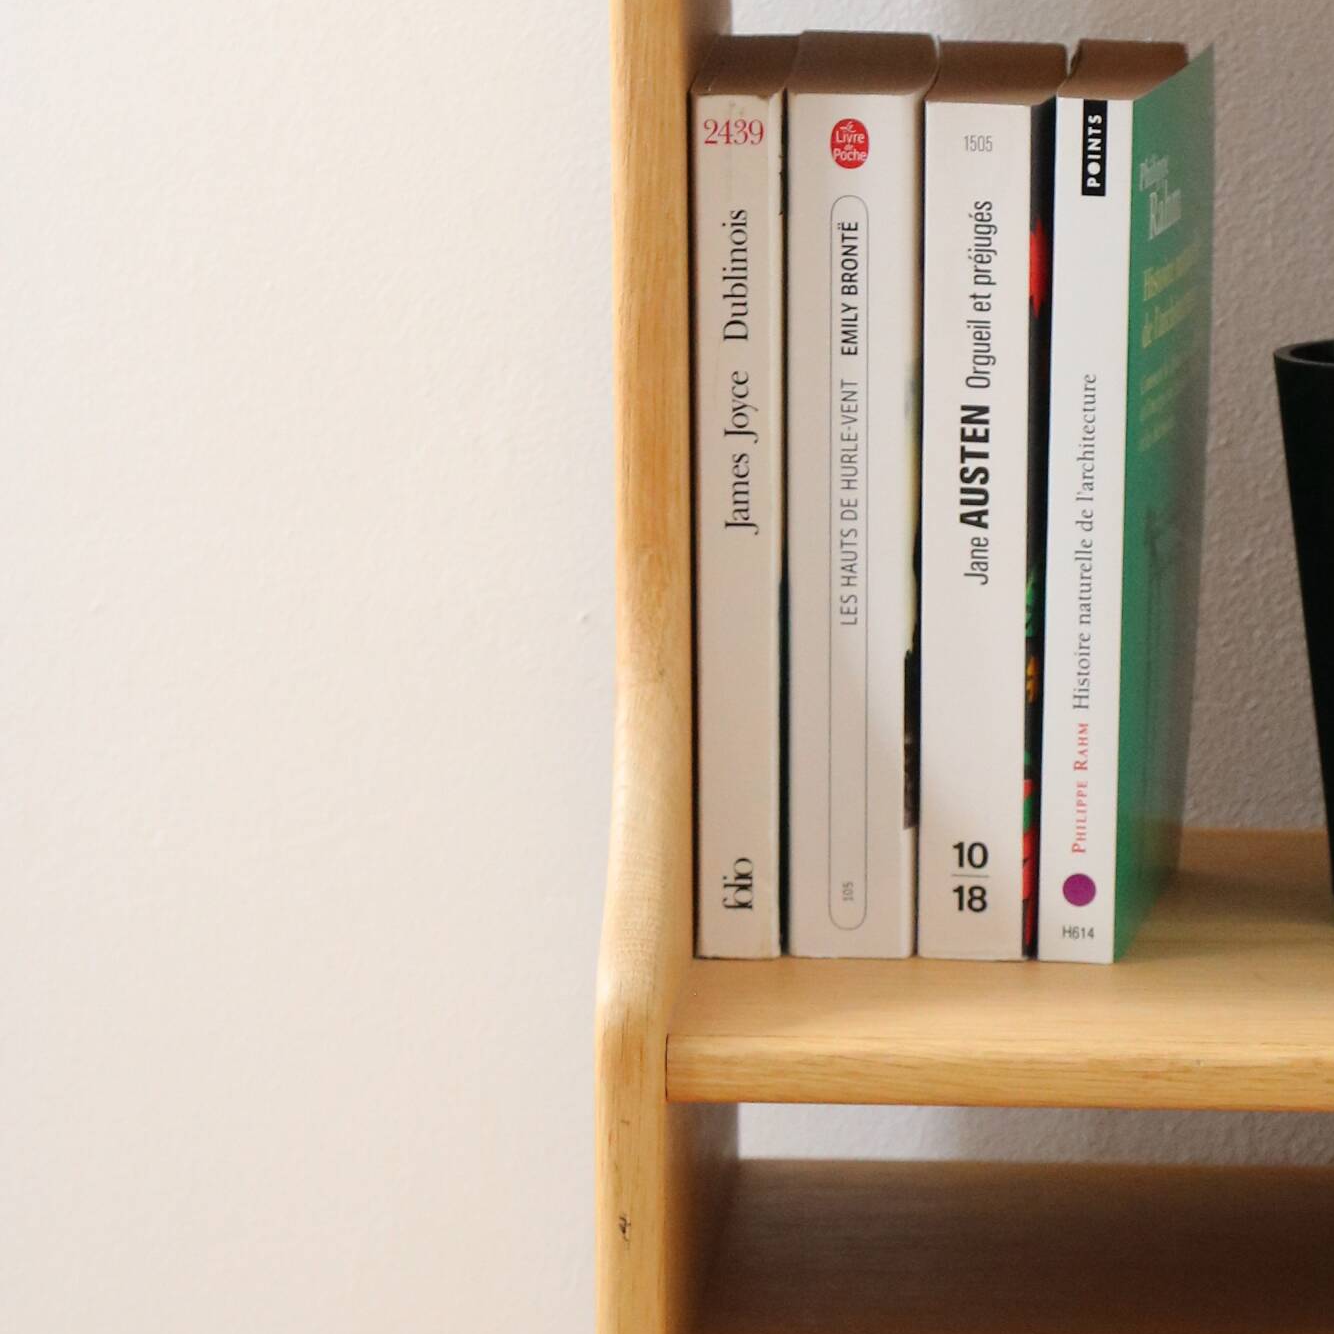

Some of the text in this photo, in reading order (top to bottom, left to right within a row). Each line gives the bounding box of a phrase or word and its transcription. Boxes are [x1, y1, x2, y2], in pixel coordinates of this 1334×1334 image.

[704, 122, 765, 145] 2439
[836, 130, 865, 144] Livre
[964, 135, 992, 152] 1505
[833, 147, 867, 162] Poche
[1086, 114, 1102, 188] POINTS
[722, 210, 758, 535] James Joyce Dublinois
[960, 201, 997, 585] Jane AUSTEN Orgueil et préjugés
[838, 223, 858, 625] LES HAUTS DE HURLE-VENT EMILY BRONTË
[1071, 375, 1096, 855] PHILIPPE RAHM Histoire naturelle de l'architecture
[953, 842, 988, 869] 10
[723, 858, 752, 909] folio
[953, 886, 987, 913] 18
[1062, 926, 1094, 939] H614
